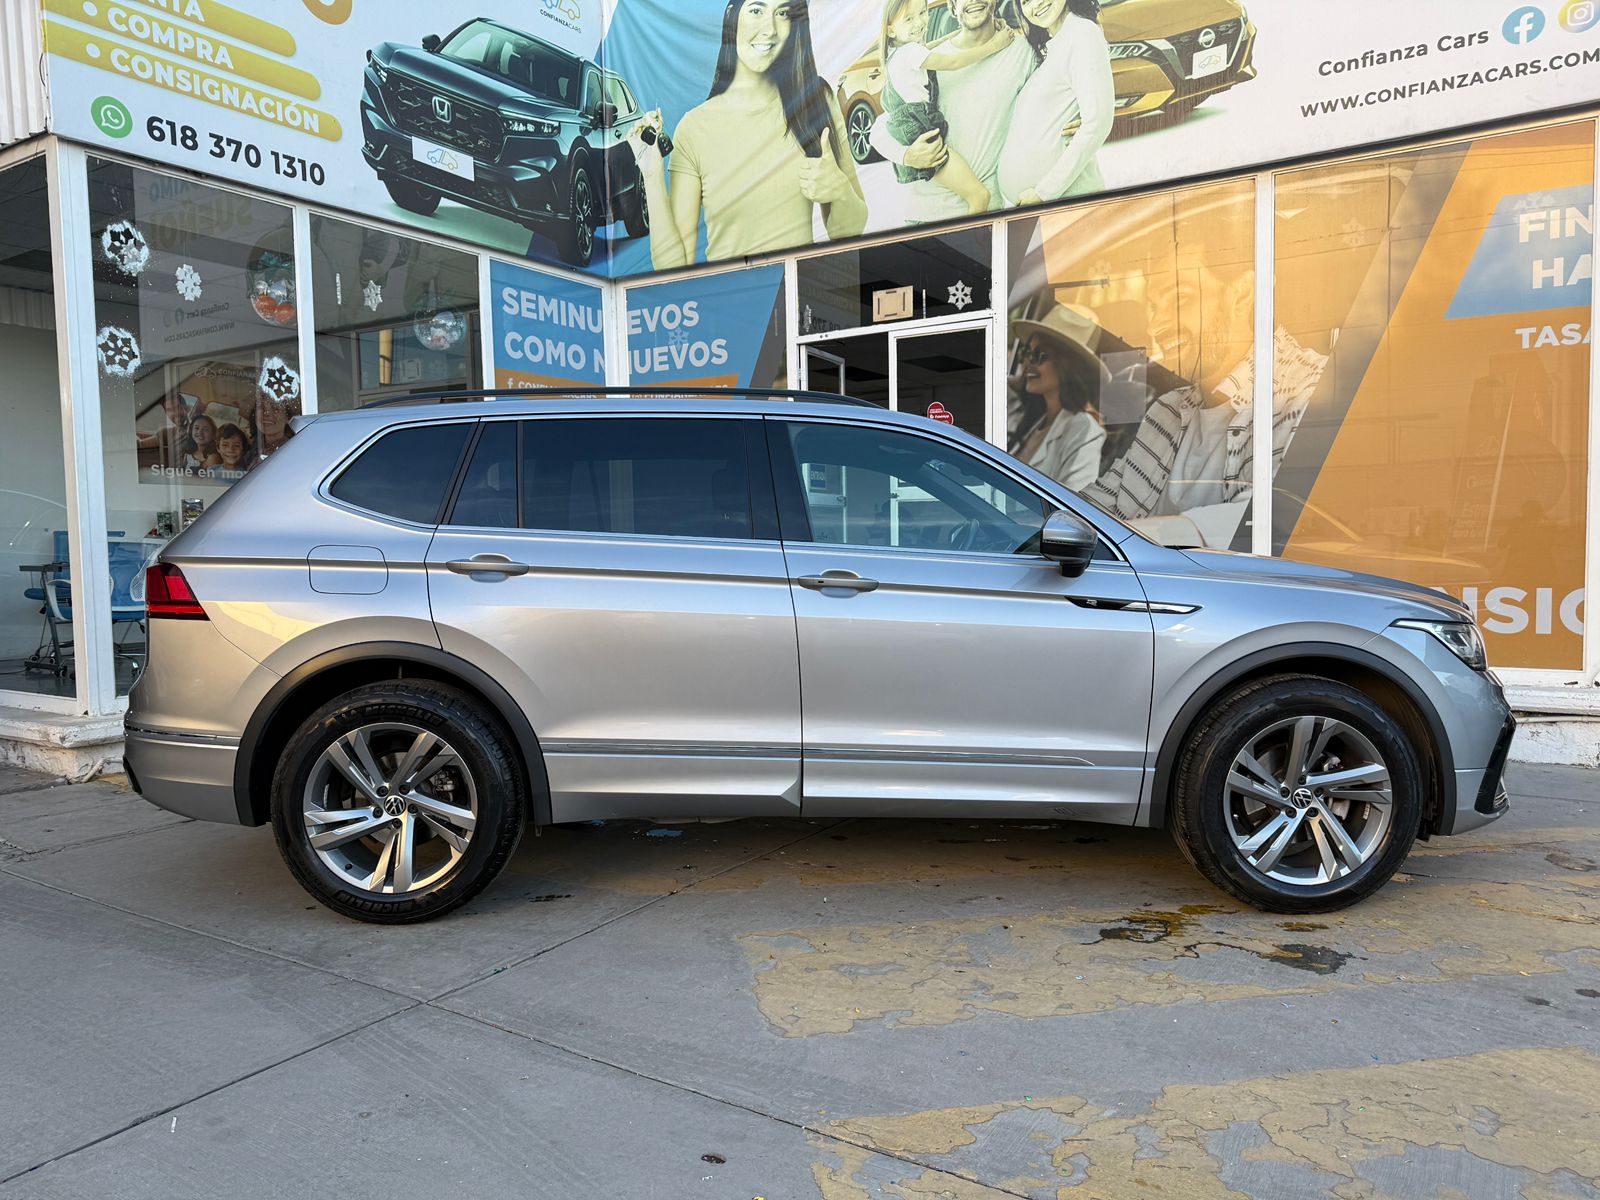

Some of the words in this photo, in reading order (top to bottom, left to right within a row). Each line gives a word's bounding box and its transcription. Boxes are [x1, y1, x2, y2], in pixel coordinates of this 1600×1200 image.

[107, 7, 234, 70] COMPRA
[1318, 44, 1428, 76] Confianza
[1437, 30, 1489, 52] Cars
[110, 48, 320, 133] CONSIGNACIÓN
[1300, 47, 1600, 118] WWW.CONFIANZACARS.COM
[146, 116, 199, 151] 618
[208, 132, 262, 168] 370
[270, 150, 326, 186] 1310
[504, 331, 586, 371] COMO
[151, 464, 194, 479] Sigue
[198, 468, 215, 478] en
